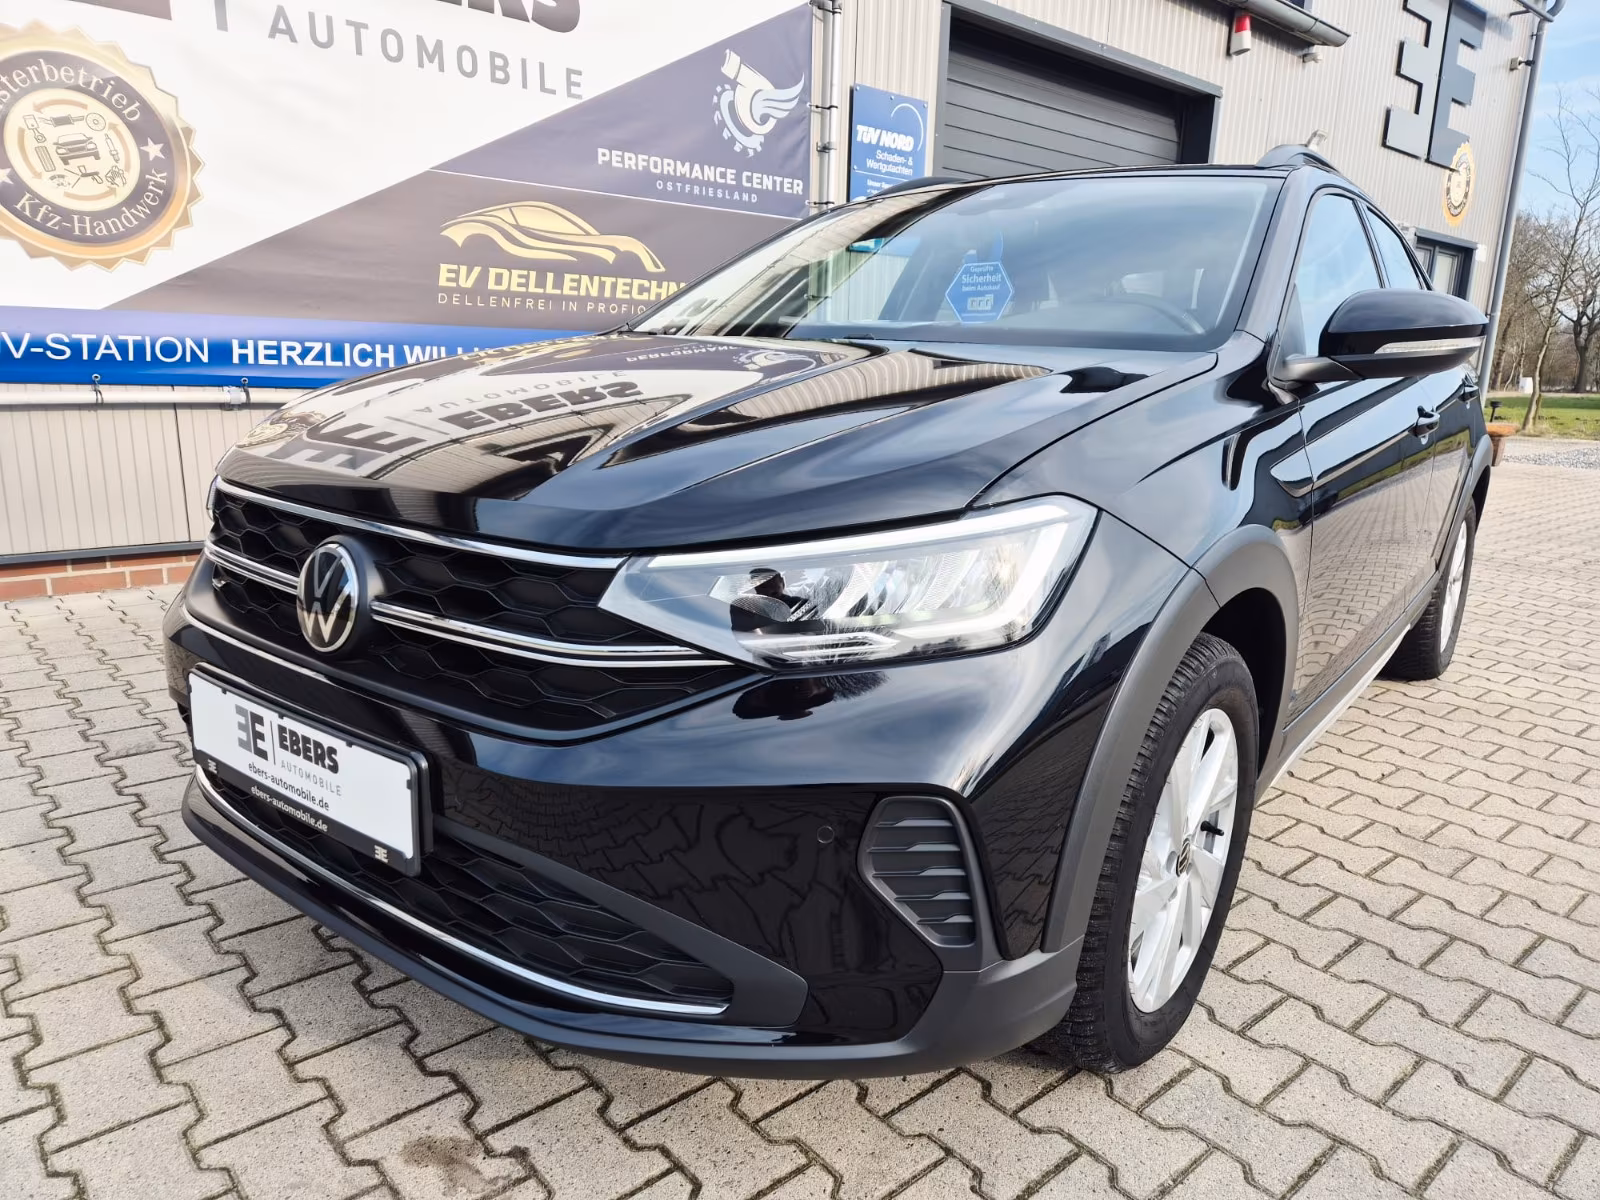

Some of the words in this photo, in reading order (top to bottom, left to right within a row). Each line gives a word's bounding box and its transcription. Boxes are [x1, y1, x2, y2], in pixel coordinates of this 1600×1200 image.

[268, 4, 583, 100] AUTOMOBILE
[876, 149, 907, 164] Schaden-
[879, 130, 914, 152] NORD
[597, 147, 737, 185] PERFORMANCE
[741, 170, 804, 195] CENTER
[866, 158, 913, 176] Wertgutachten
[14, 168, 168, 236] Kfz-Handwerk
[656, 179, 758, 203] OSTFRIESLAND
[438, 262, 482, 289] EV
[961, 272, 1002, 283] Sicherheit
[438, 292, 552, 310] DELLENFREI
[562, 300, 577, 312] IN
[0, 331, 209, 363] V-STATION
[231, 338, 395, 368] HERZLICH
[277, 723, 340, 774] EBERS
[248, 762, 330, 812] ebers-automobile.de
[280, 759, 342, 797] AUTOMOBILE
[250, 784, 328, 833] ebers-automobile.de
